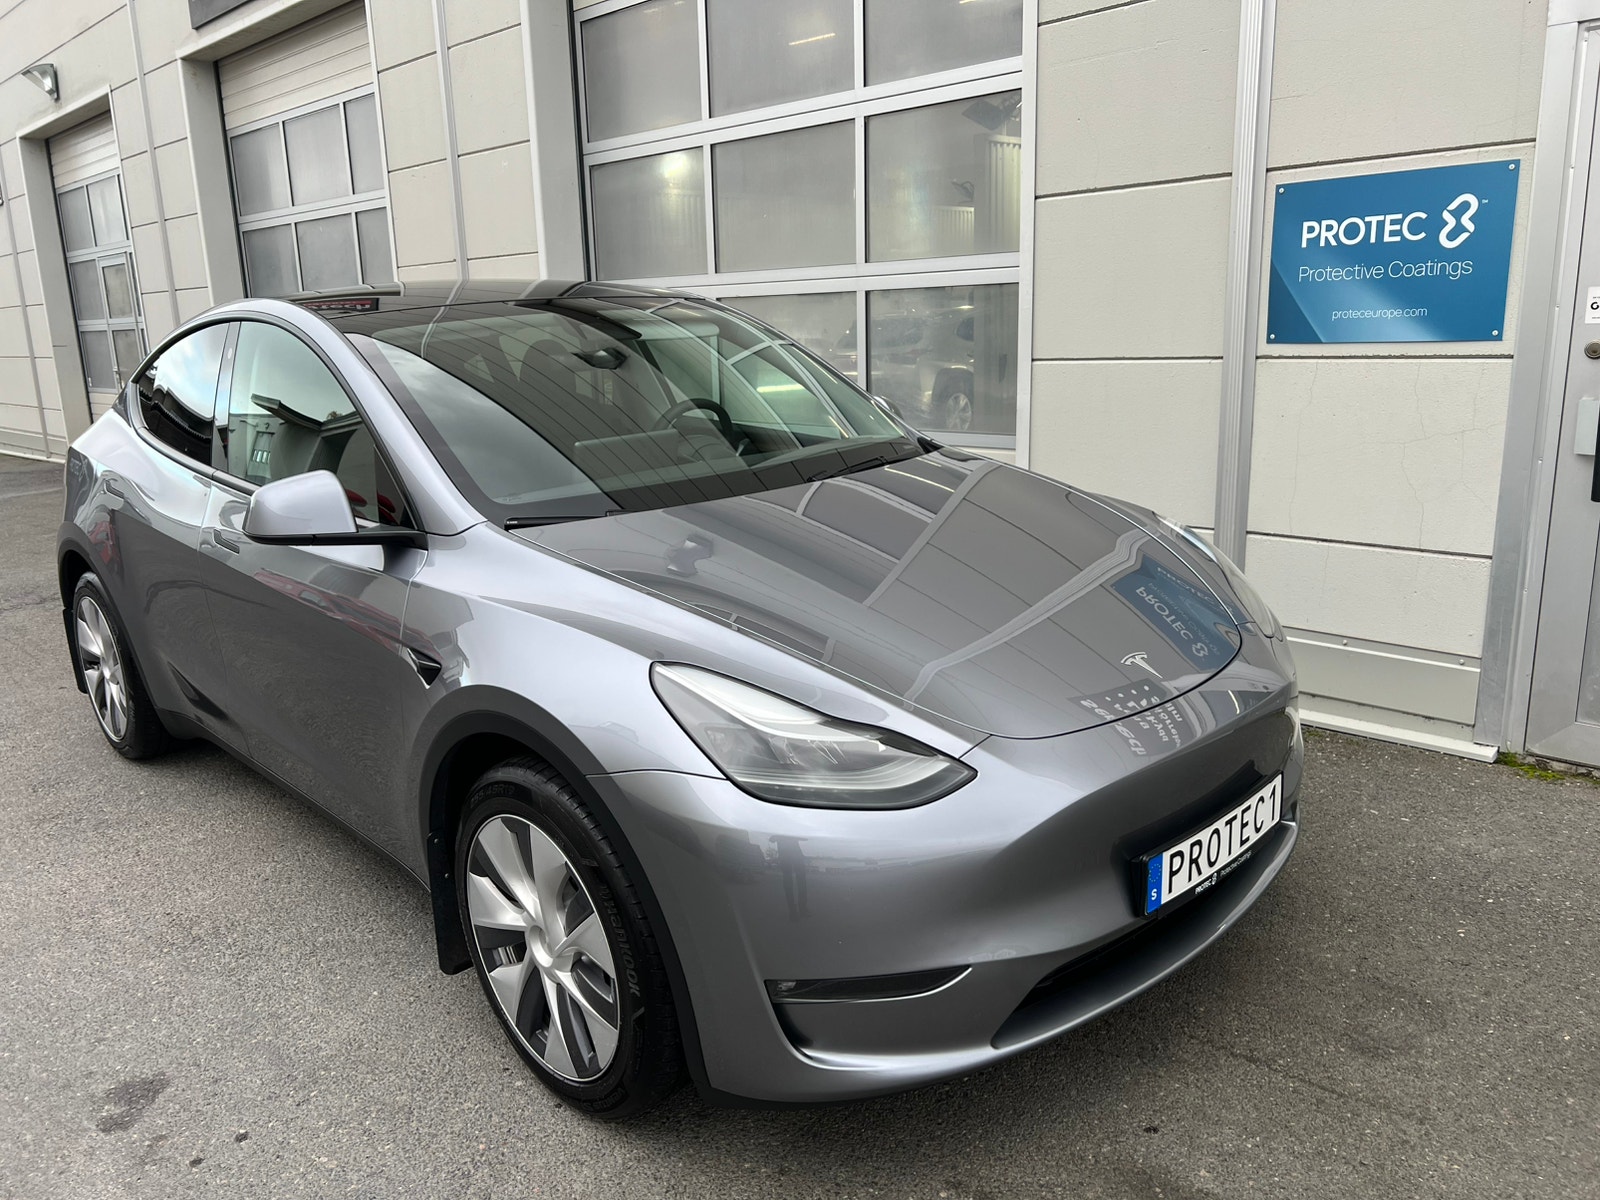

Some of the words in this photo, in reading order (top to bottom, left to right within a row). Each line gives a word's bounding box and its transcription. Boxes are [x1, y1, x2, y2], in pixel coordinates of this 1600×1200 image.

[1301, 211, 1428, 248] PROTEC
[1298, 263, 1384, 282] Protective
[1388, 259, 1473, 280] Coatings
[1331, 306, 1428, 321] proteceurope.com
[1151, 889, 1158, 901] S
